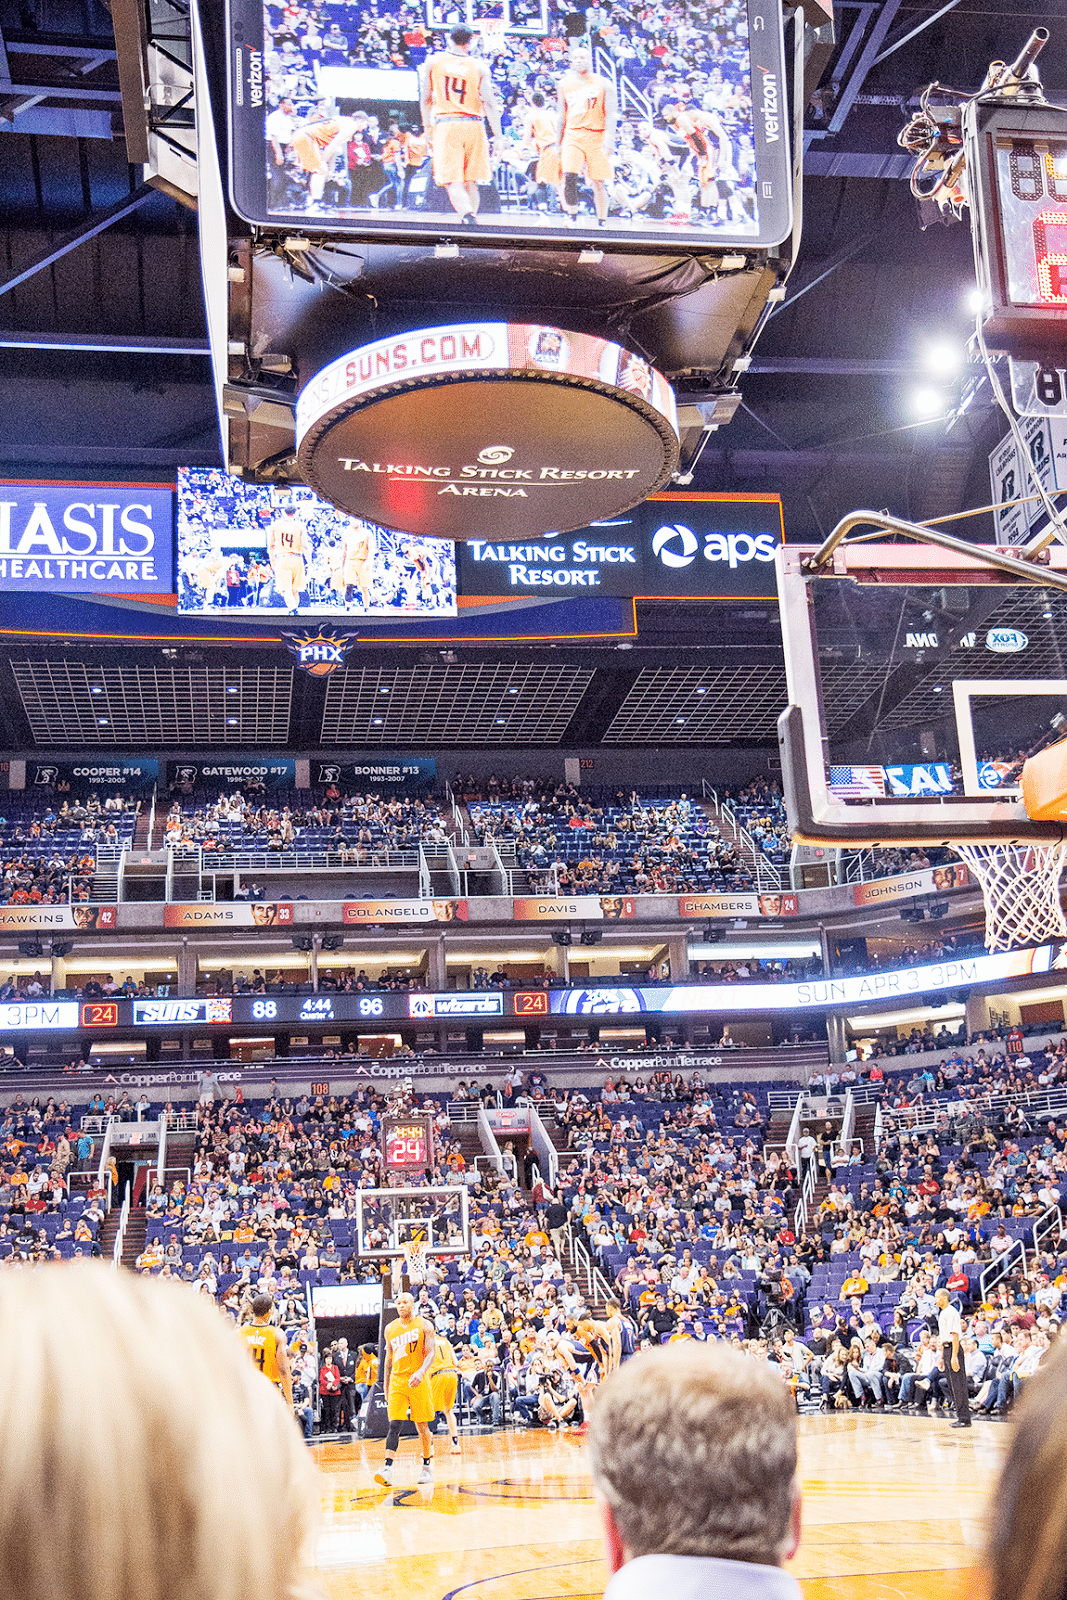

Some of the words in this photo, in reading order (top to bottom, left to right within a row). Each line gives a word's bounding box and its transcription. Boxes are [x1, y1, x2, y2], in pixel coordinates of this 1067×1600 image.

[247, 52, 263, 108] verizon
[445, 76, 466, 104] 14
[761, 74, 779, 143] verizon
[346, 334, 481, 388] SUNS.COM
[338, 458, 451, 476] TALKING
[459, 465, 533, 480] STICK
[539, 467, 640, 480] RESORT
[437, 484, 528, 498] ARENA
[0, 502, 155, 556] IASIS
[281, 532, 293, 548] 14
[467, 540, 565, 563] TALKING
[573, 541, 636, 563] STICK
[704, 533, 776, 568] aps
[300, 646, 343, 661] PHX
[202, 766, 268, 776] GATEWOOD
[271, 766, 287, 775] #17
[354, 766, 400, 775] BONNER
[403, 766, 419, 775] #13
[580, 759, 594, 768] 212
[73, 767, 119, 776] COOPER
[123, 767, 141, 776] #14
[864, 881, 923, 898] JOHNSON
[958, 869, 965, 881] 7
[348, 907, 429, 917] COLANGELO
[538, 905, 577, 914] DAVIS
[626, 902, 633, 914] 6
[685, 902, 753, 911] CHAMBERS
[784, 899, 795, 911] 24
[102, 911, 113, 923] 42
[183, 911, 234, 920] ADAMS
[279, 908, 290, 920] 33
[797, 981, 847, 1004] SUN
[859, 973, 900, 997] APR
[907, 970, 920, 990] 3
[931, 961, 978, 987] 3PM
[252, 1000, 277, 1018] 88
[302, 998, 331, 1011] 4:44
[359, 997, 383, 1015] 96
[522, 996, 544, 1011] 24
[7, 1005, 60, 1026] 3PM
[91, 1007, 113, 1022] 24
[1007, 1040, 1022, 1052] 110
[610, 1055, 722, 1071] CopperPointTerrace
[120, 1071, 242, 1086] CopperPointTrace
[311, 1083, 329, 1095] 108
[396, 1126, 423, 1138] 4:44
[393, 1140, 420, 1162] 24
[409, 1340, 418, 1353] 17
